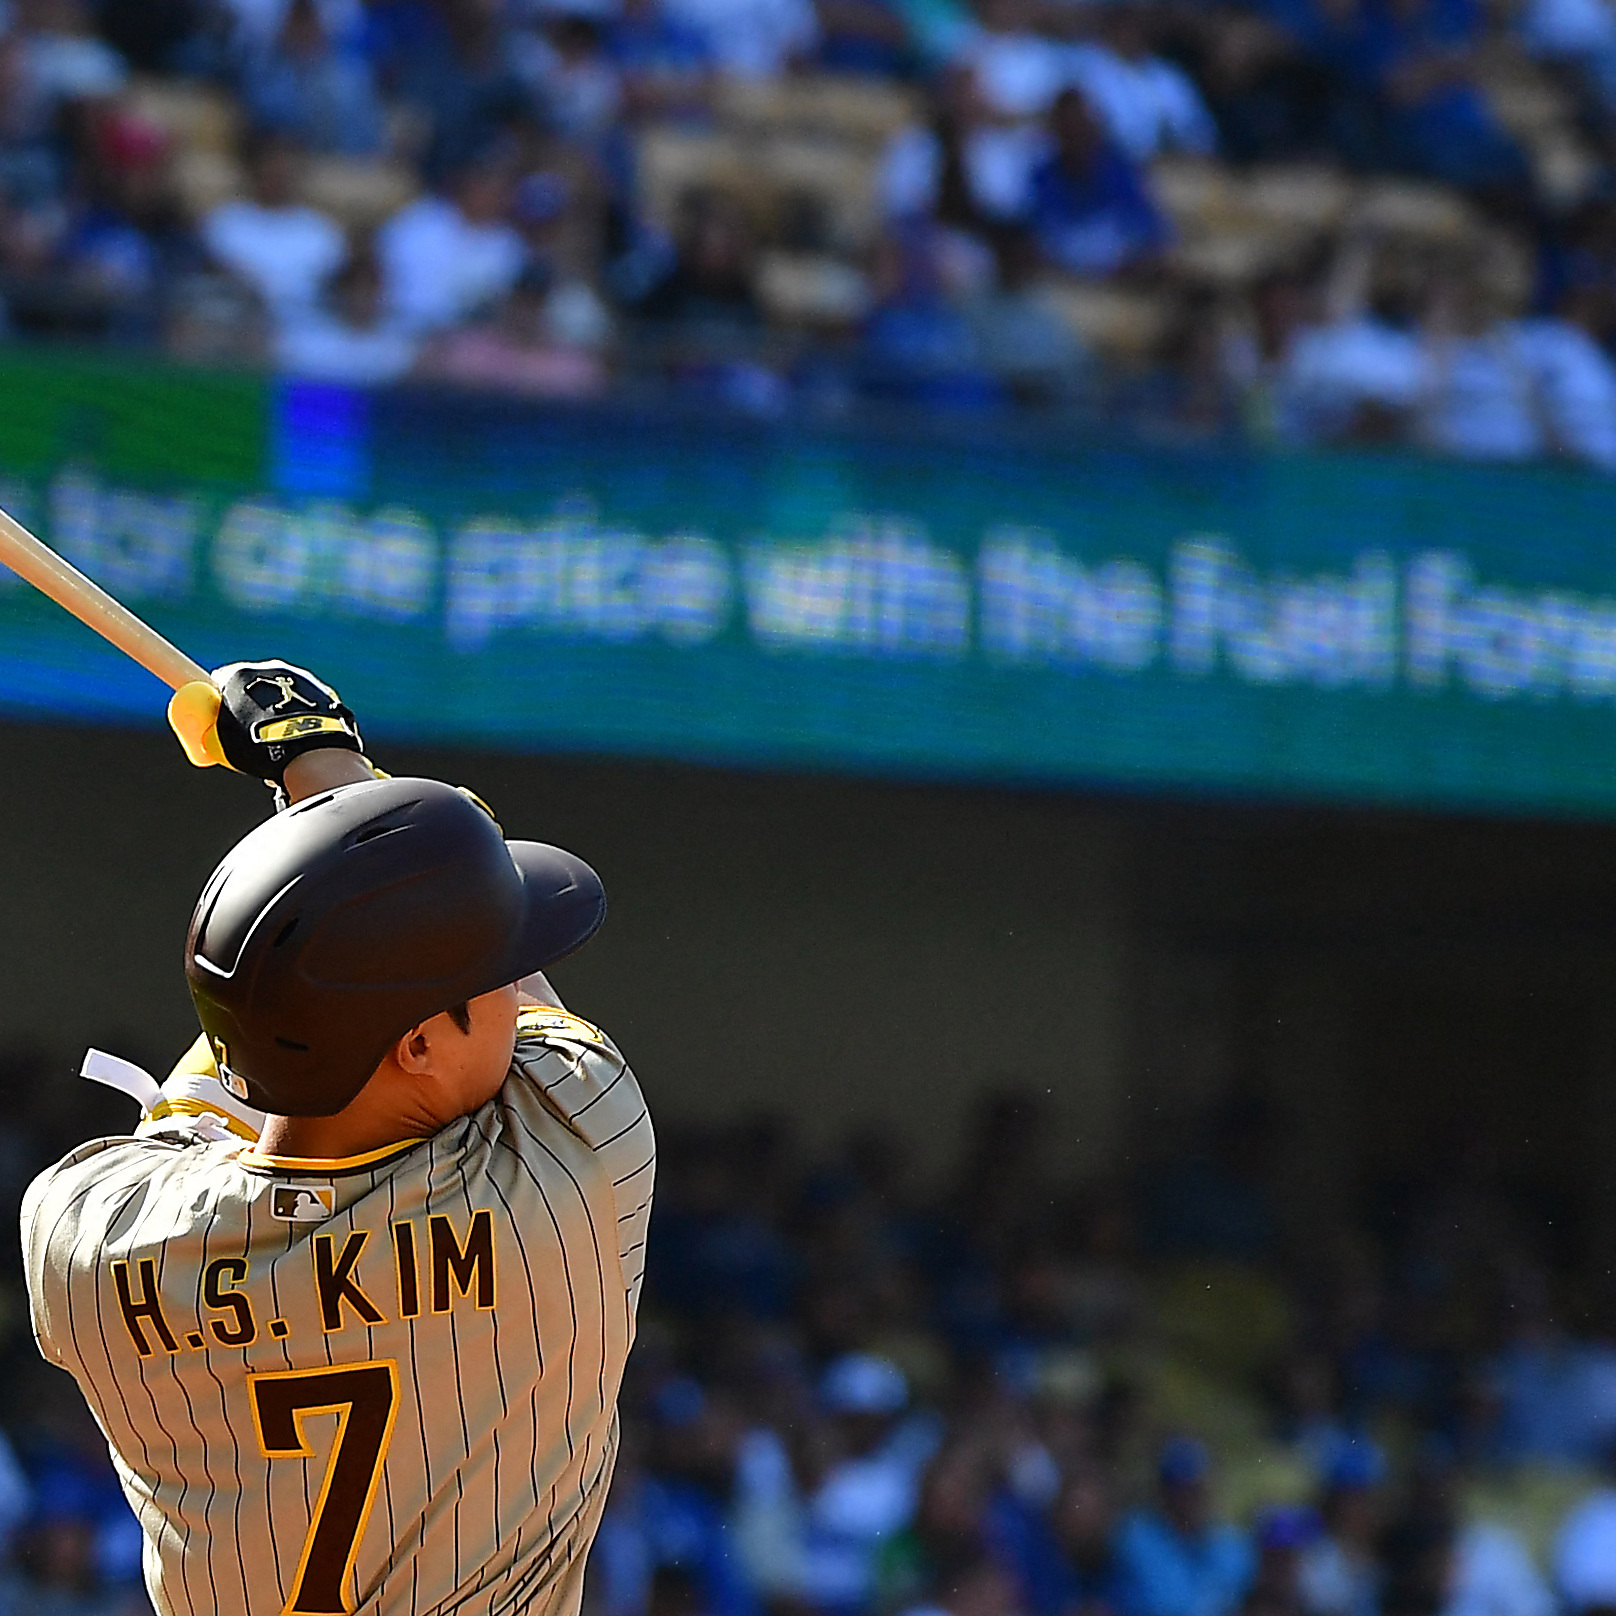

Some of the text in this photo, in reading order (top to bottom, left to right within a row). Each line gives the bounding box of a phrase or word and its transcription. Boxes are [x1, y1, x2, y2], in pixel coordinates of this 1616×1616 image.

[213, 494, 432, 614] one
[446, 486, 734, 658] price
[740, 508, 972, 662] with
[976, 520, 1162, 676] the
[1168, 530, 1400, 692] Fuel
[110, 1208, 499, 1360] H.S. KIM
